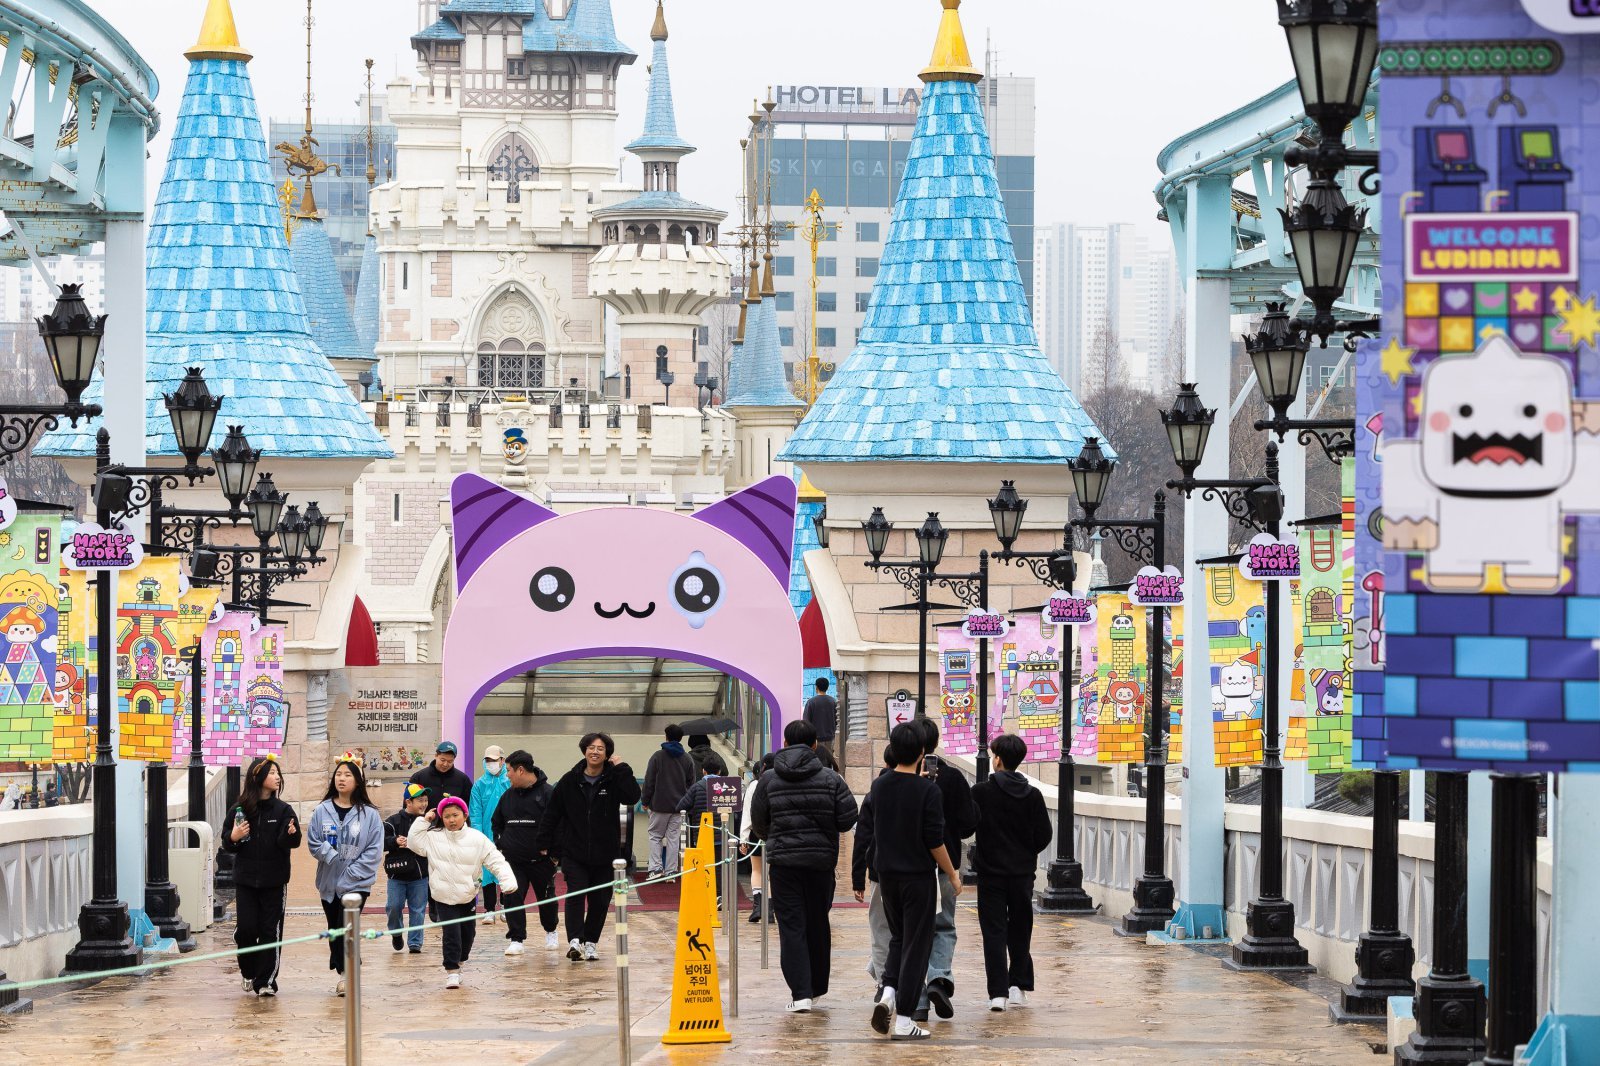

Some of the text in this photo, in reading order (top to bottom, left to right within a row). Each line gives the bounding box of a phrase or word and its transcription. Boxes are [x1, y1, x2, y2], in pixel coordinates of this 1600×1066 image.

[776, 86, 873, 105] HOTEL
[771, 158, 822, 175] SKY
[1428, 227, 1555, 246] WELCOME
[74, 533, 128, 547] MAPLE
[75, 546, 128, 560] STORY
[1249, 544, 1300, 558] MAPLE
[76, 559, 130, 567] LOTTEWORLD
[1251, 557, 1300, 569] STORY
[1137, 575, 1179, 587] MAPLE
[1138, 586, 1180, 597] STORY
[1050, 598, 1087, 609] MAPLE
[1051, 607, 1087, 617] STORY
[969, 615, 1000, 624] MAPLE
[969, 623, 1001, 631] STORY
[357, 690, 418, 699] 기념사진 촬영은
[348, 701, 427, 710] 오른편 대기 라인에서
[357, 712, 391, 721] 차례대로
[357, 723, 418, 732] 주시기 바랍니다
[684, 964, 711, 975] 넘어짐
[689, 975, 707, 987] 주의
[684, 996, 696, 1004] WET
